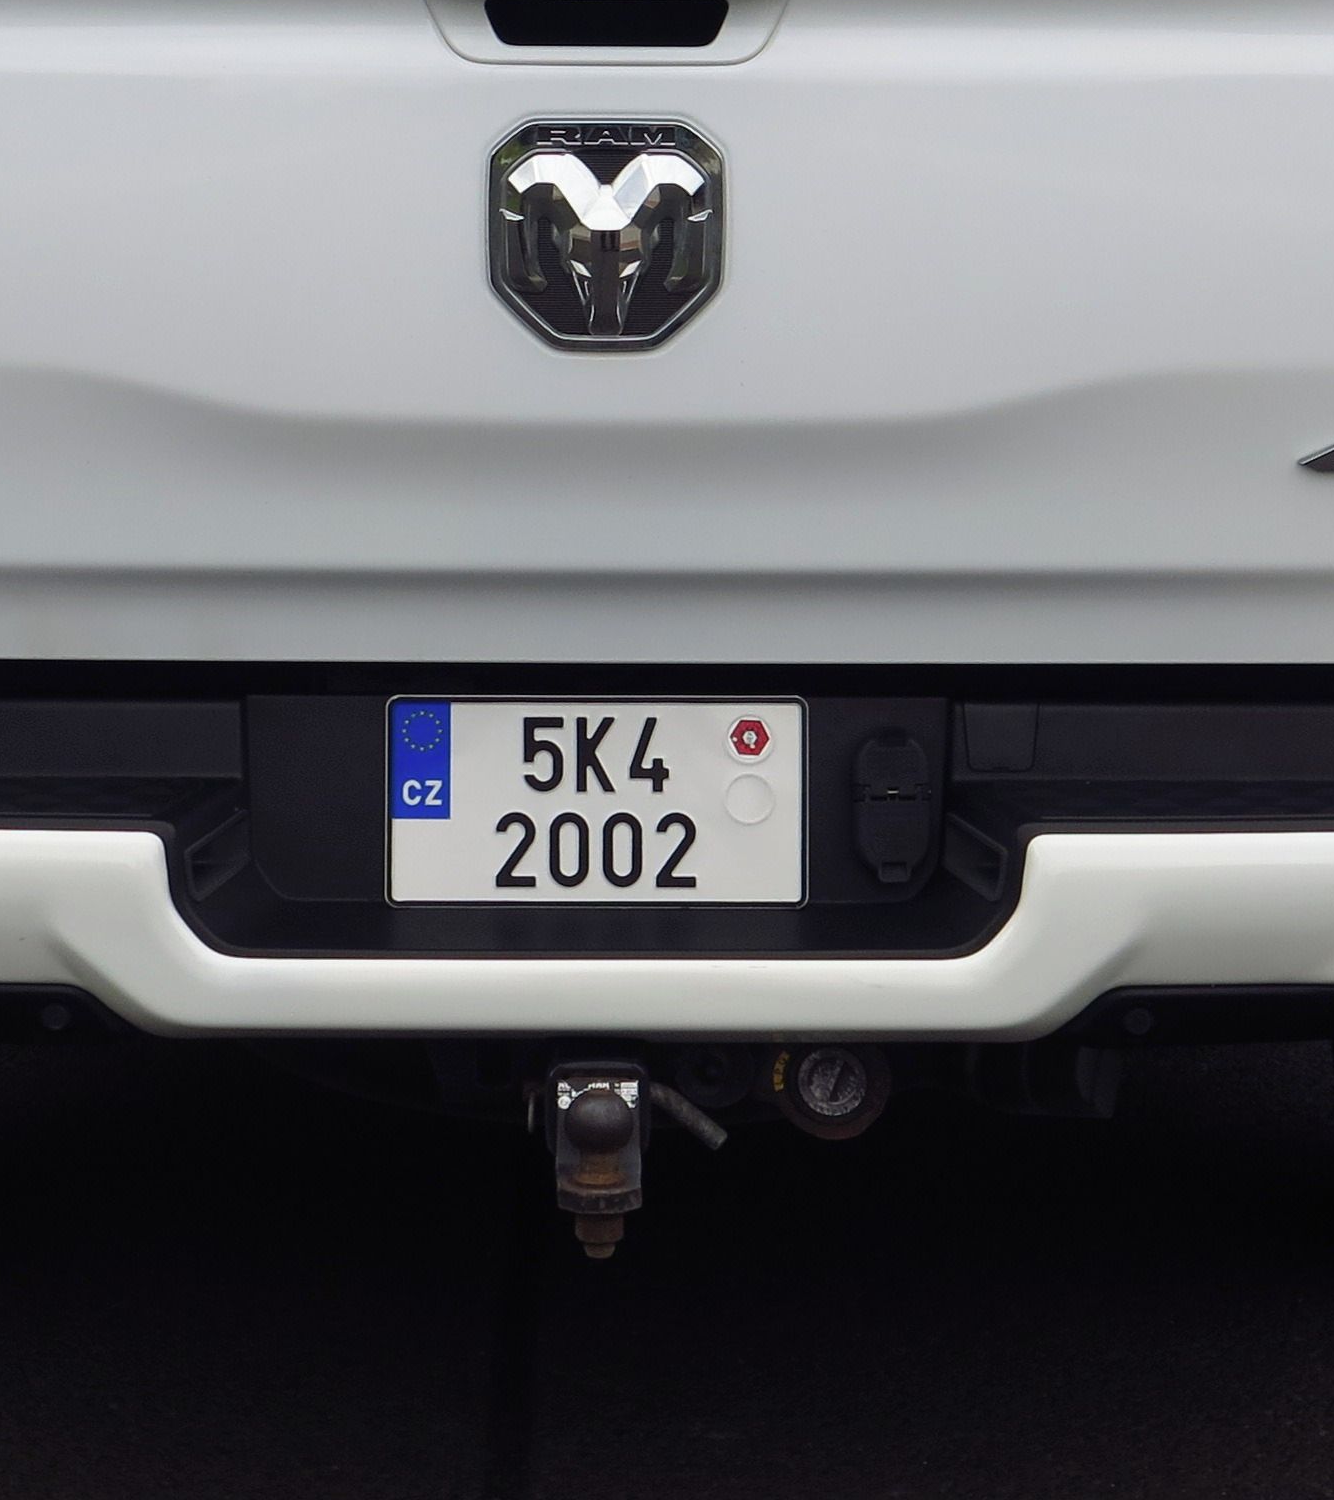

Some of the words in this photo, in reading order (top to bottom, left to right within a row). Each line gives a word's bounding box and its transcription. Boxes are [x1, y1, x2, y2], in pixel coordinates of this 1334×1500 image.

[536, 127, 675, 146] RAM
[523, 716, 669, 793] 5K4
[402, 780, 444, 806] CZ
[494, 812, 698, 889] 2002
